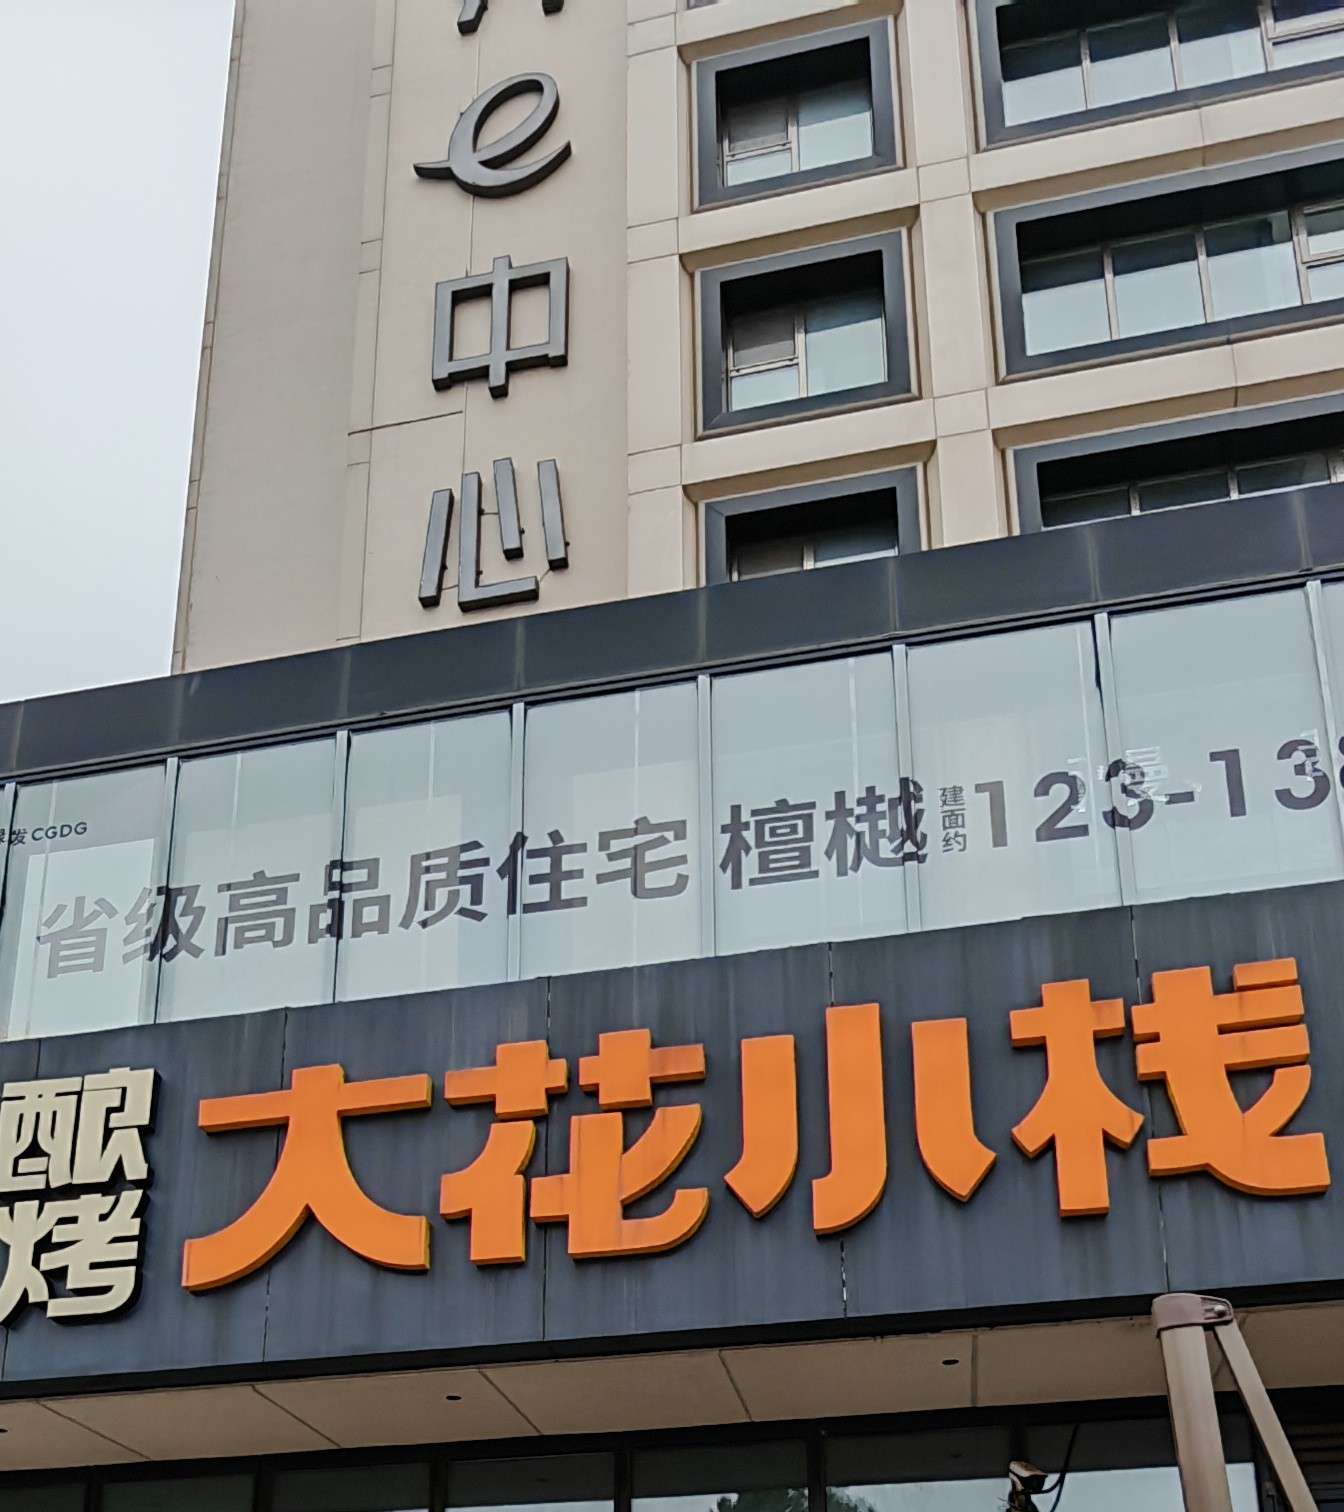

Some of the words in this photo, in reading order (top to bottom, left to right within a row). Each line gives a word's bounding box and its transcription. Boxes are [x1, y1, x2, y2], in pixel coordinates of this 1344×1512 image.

[413, 0, 572, 612] e中心
[31, 821, 88, 842] CGDG
[38, 815, 690, 980] 省级高品质住宅
[938, 784, 968, 854] 建面约
[182, 956, 1332, 1292] 大花小栈
